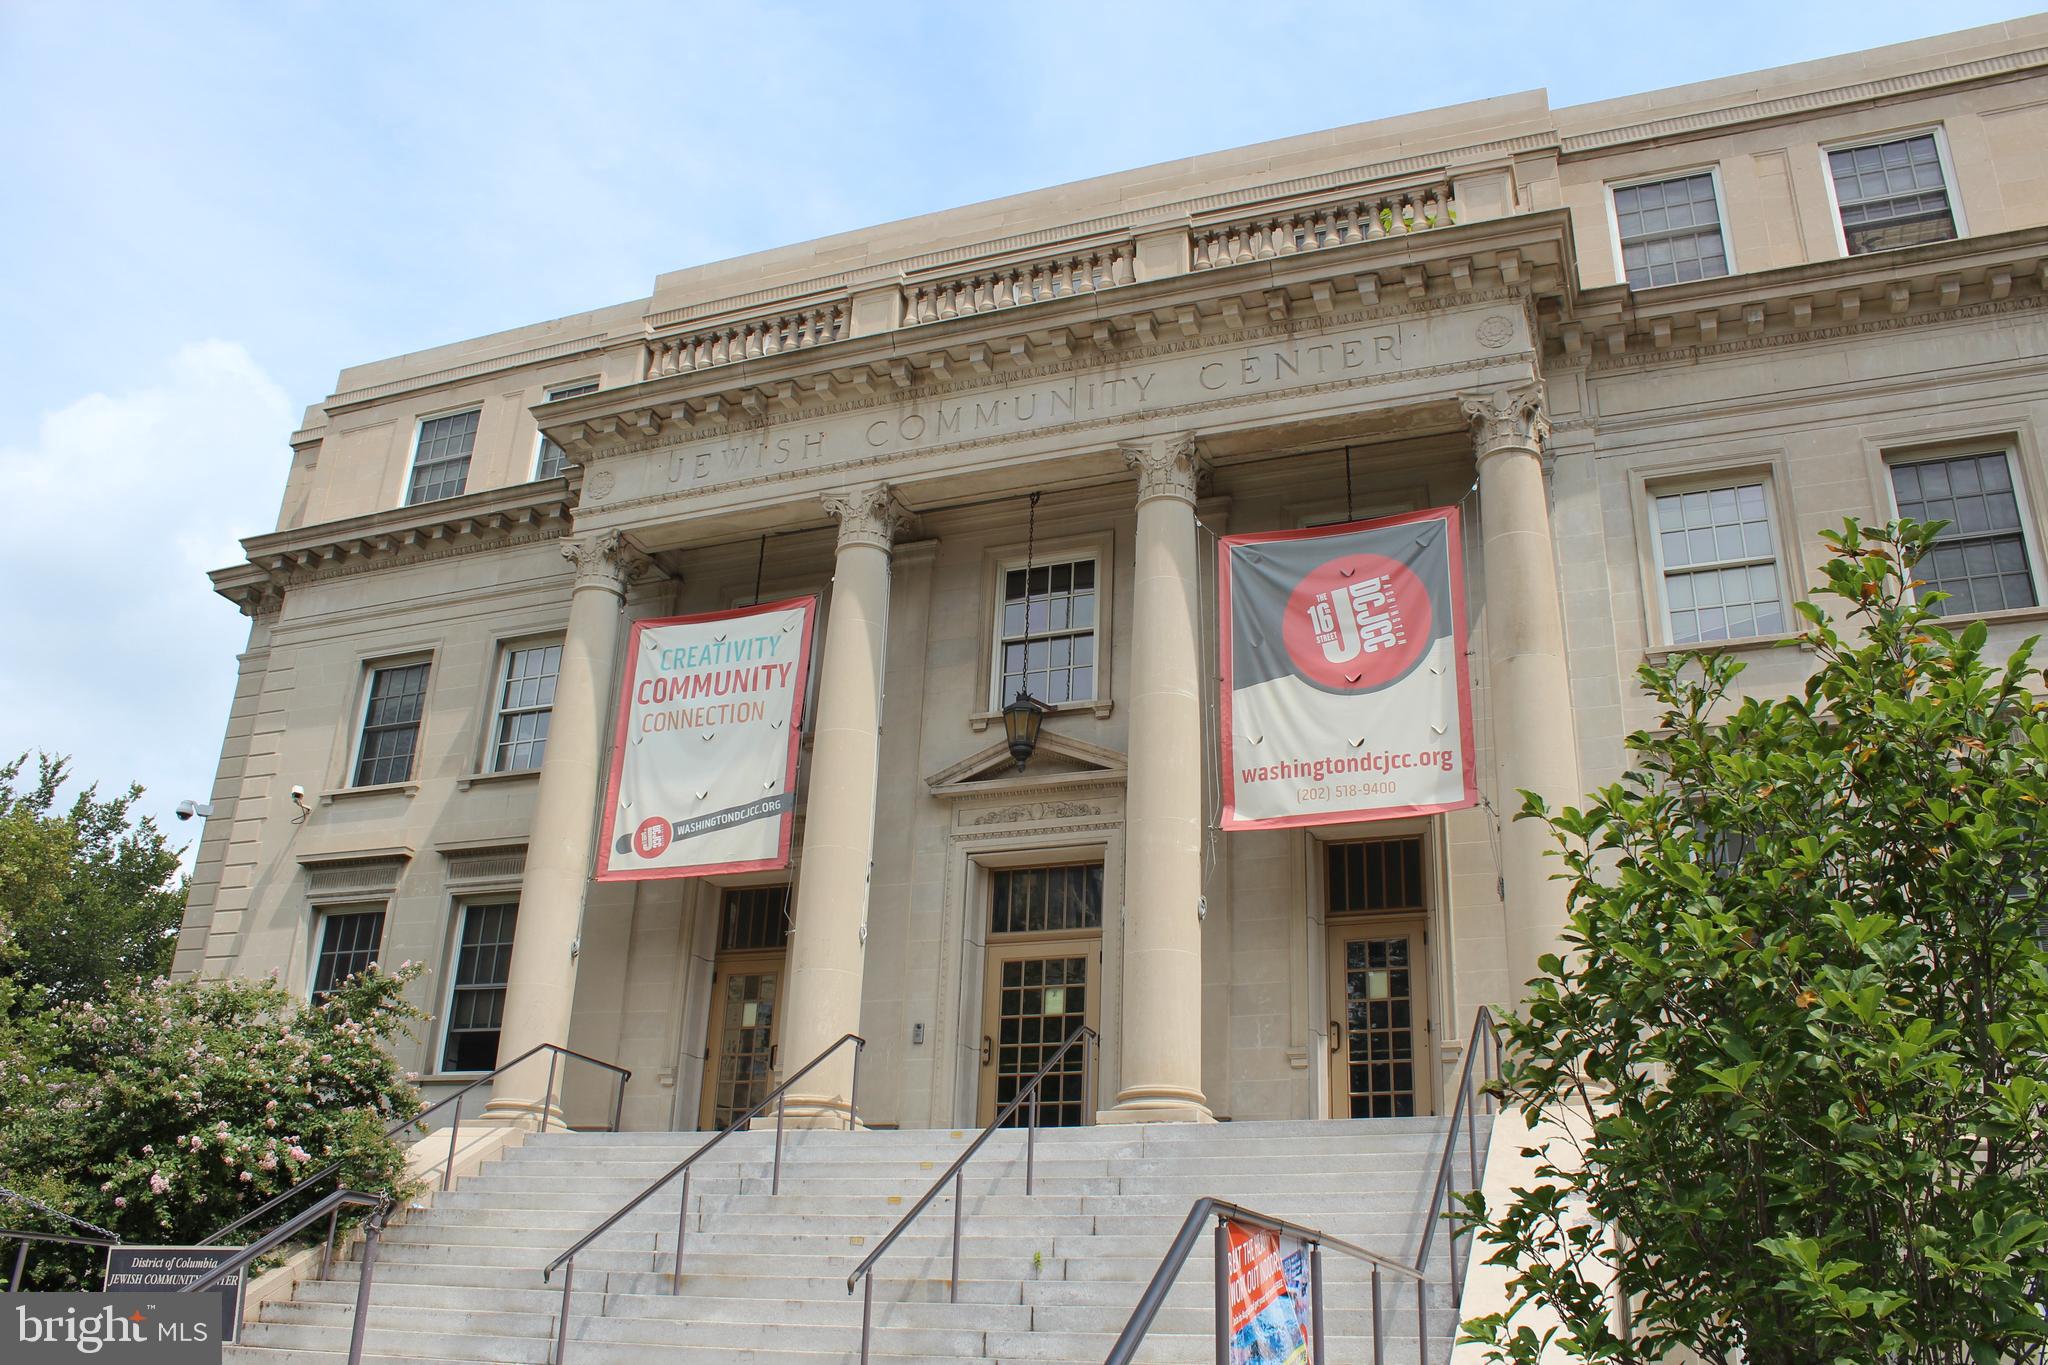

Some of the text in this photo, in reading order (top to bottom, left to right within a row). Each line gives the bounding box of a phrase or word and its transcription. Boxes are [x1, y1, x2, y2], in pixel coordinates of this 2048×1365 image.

[667, 335, 1402, 483] JEWISH COMMUNITY CENTER
[1316, 592, 1328, 602] THE
[1349, 576, 1397, 653] DCJCC
[660, 634, 782, 672] CREATIVITY
[1316, 631, 1338, 644] STREET
[637, 661, 793, 705] COMMUNITY
[642, 701, 766, 733] CONNECTION
[1242, 750, 1454, 784] washingtondcjcc.org
[1296, 781, 1396, 804] (202) 518-9400
[677, 799, 782, 836] WASHINGTONDCJCC.ORG
[108, 1274, 142, 1287] JEWISH
[144, 1274, 202, 1286] COMMUNITY
[131, 1257, 218, 1271] District of Columbia
